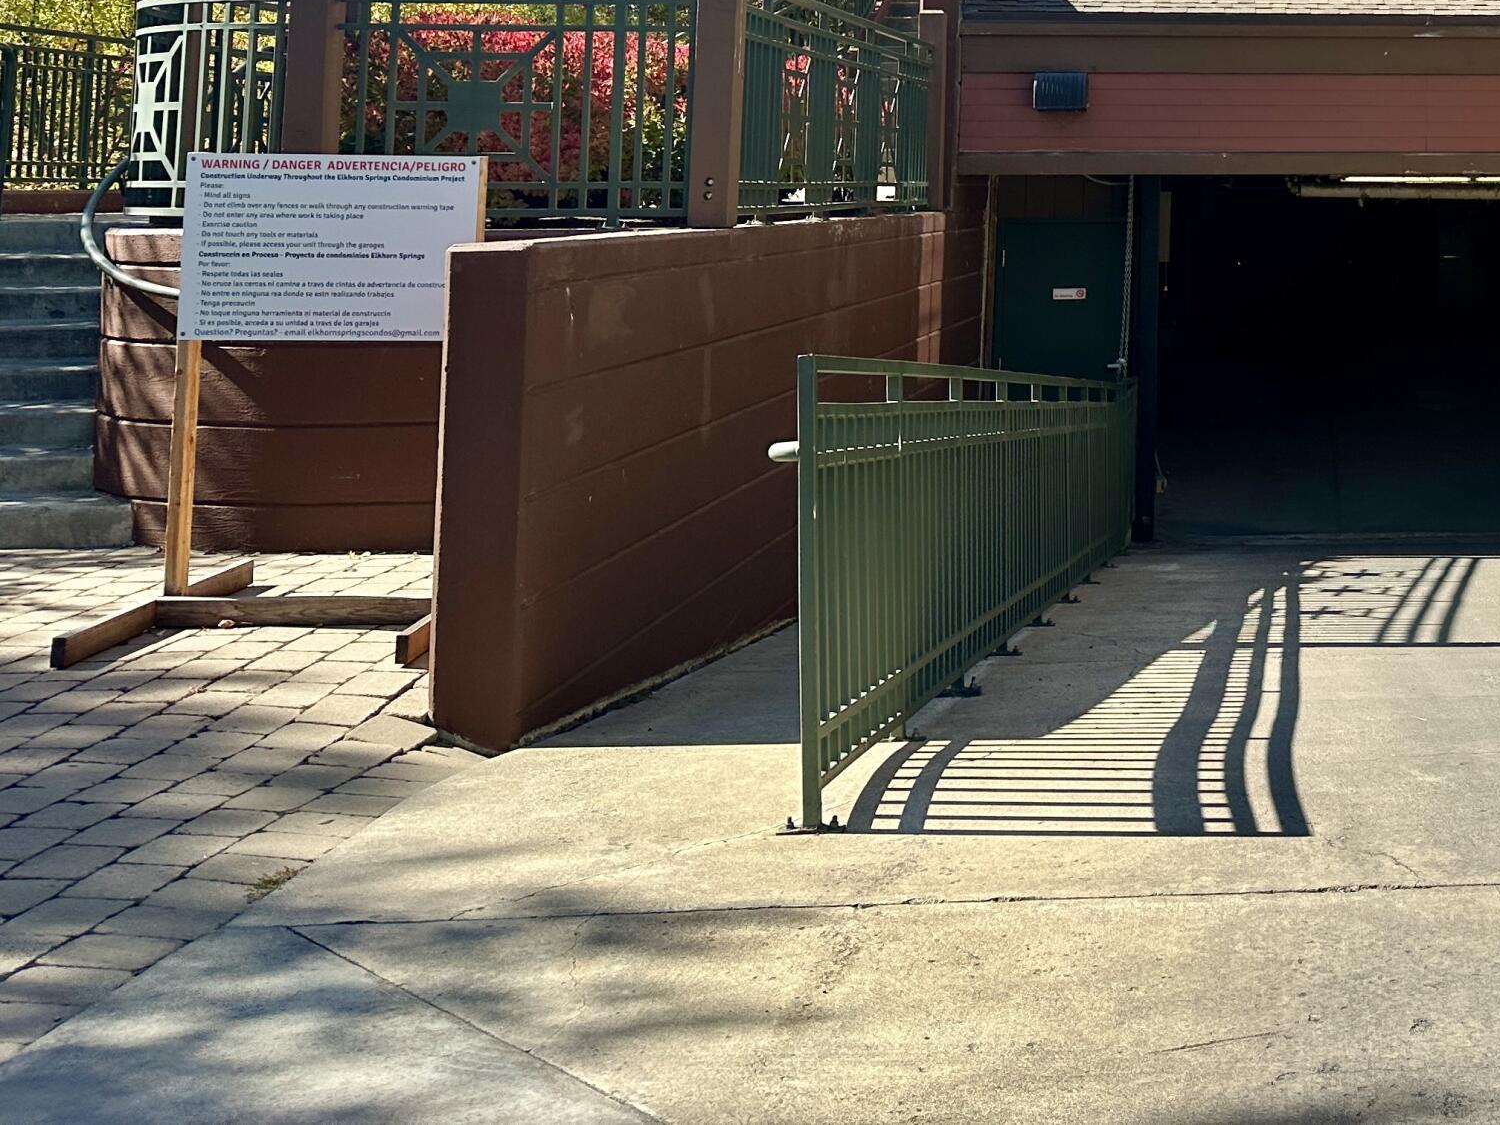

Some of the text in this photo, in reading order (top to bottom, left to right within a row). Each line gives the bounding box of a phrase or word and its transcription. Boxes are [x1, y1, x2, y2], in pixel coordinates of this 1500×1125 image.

[202, 159, 260, 169] WARNING
[272, 160, 321, 170] DANGER
[328, 161, 466, 173] ADVERTENCIA/PELIGRO
[247, 173, 282, 181] Underway
[284, 173, 323, 181] Throughout
[365, 174, 391, 182] Springs
[441, 175, 465, 183] Project
[326, 203, 352, 211] through
[411, 204, 438, 212] warning
[318, 241, 344, 249] through
[399, 253, 425, 261] Springs
[202, 270, 229, 278] Respete
[367, 291, 394, 299] trabajos
[201, 299, 220, 308] Tenga
[216, 319, 243, 327] posible,
[194, 328, 233, 337] Question?
[235, 328, 278, 337] Preguntas?
